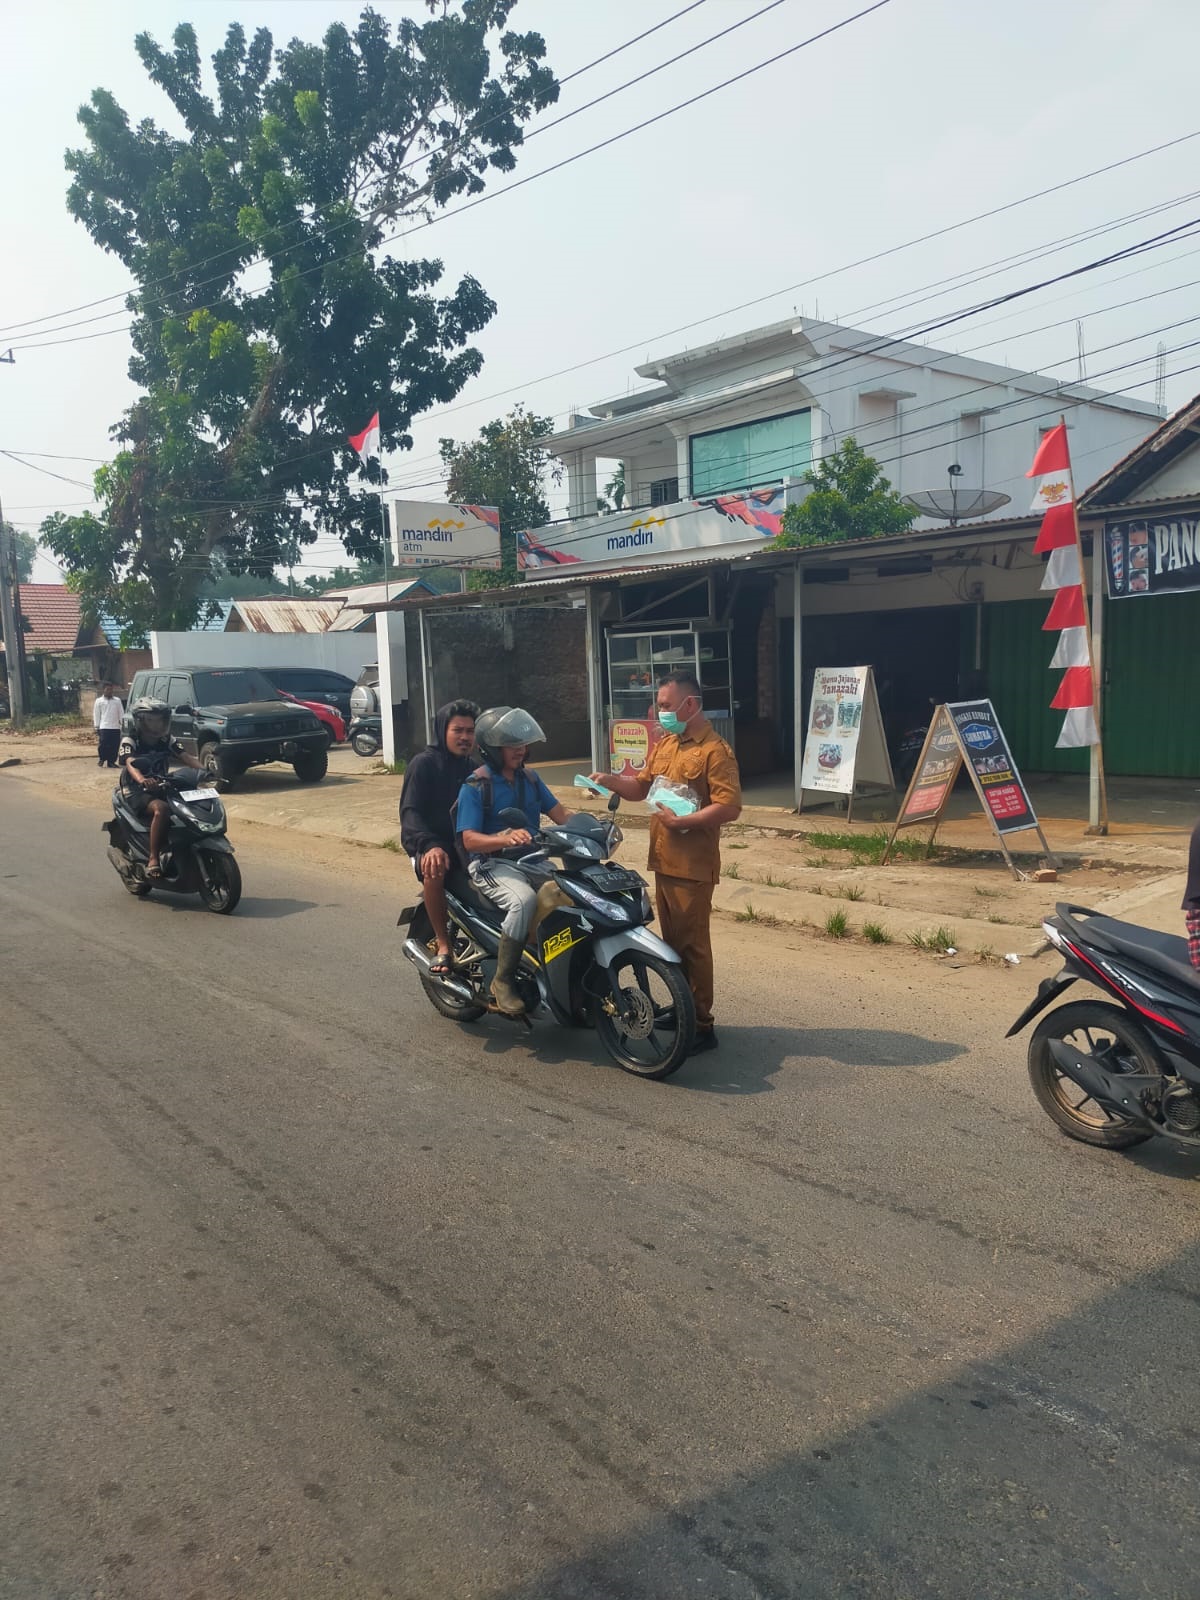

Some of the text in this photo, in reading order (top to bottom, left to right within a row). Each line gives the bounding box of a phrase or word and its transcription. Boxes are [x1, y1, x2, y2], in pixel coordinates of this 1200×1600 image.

[402, 526, 453, 542] mandiri
[607, 528, 653, 551] mandiri
[403, 543, 422, 552] atm
[543, 927, 572, 956] 125
